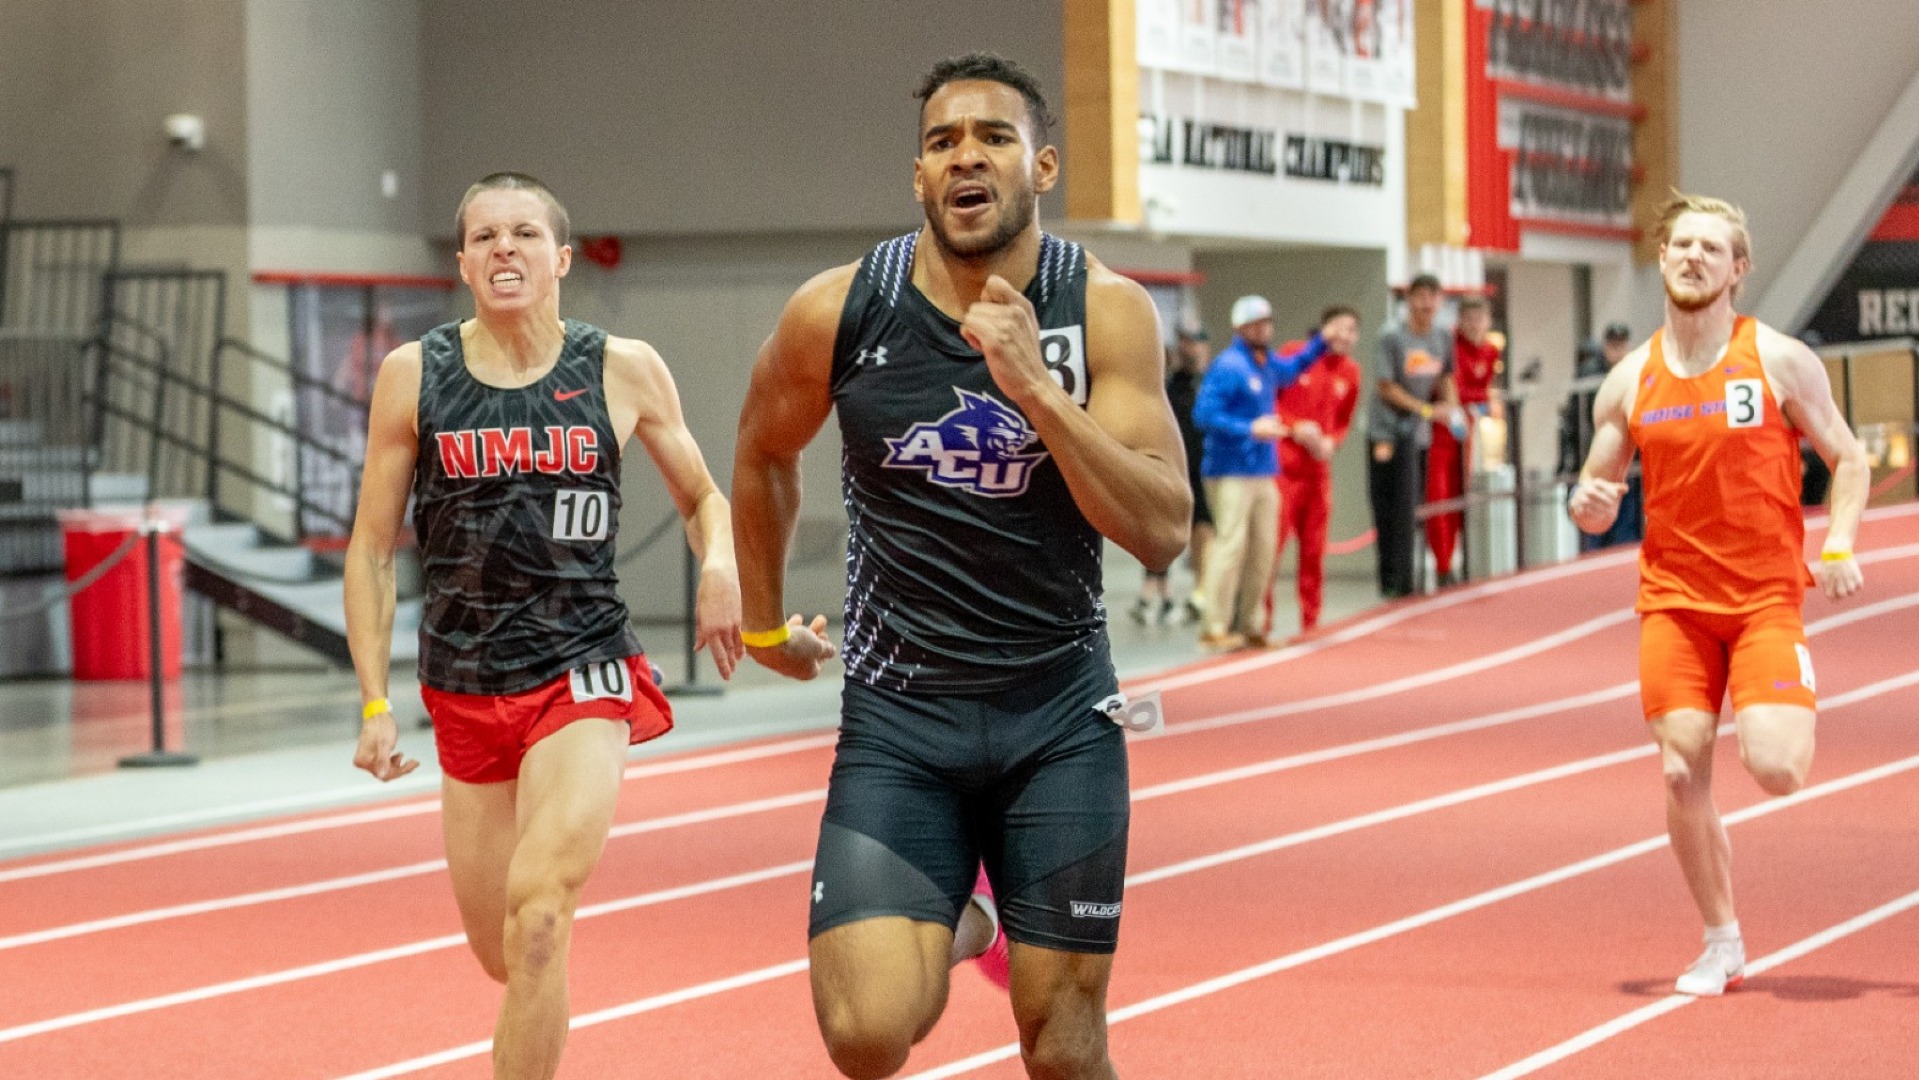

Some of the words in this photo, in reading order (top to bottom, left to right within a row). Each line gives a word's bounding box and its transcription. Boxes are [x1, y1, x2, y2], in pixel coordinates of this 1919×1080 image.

[1041, 335, 1075, 396] 8
[1733, 384, 1755, 423] 3
[435, 426, 598, 478] NMJC
[899, 430, 1026, 490] ACU
[560, 493, 601, 538] 10
[574, 658, 624, 696] 10
